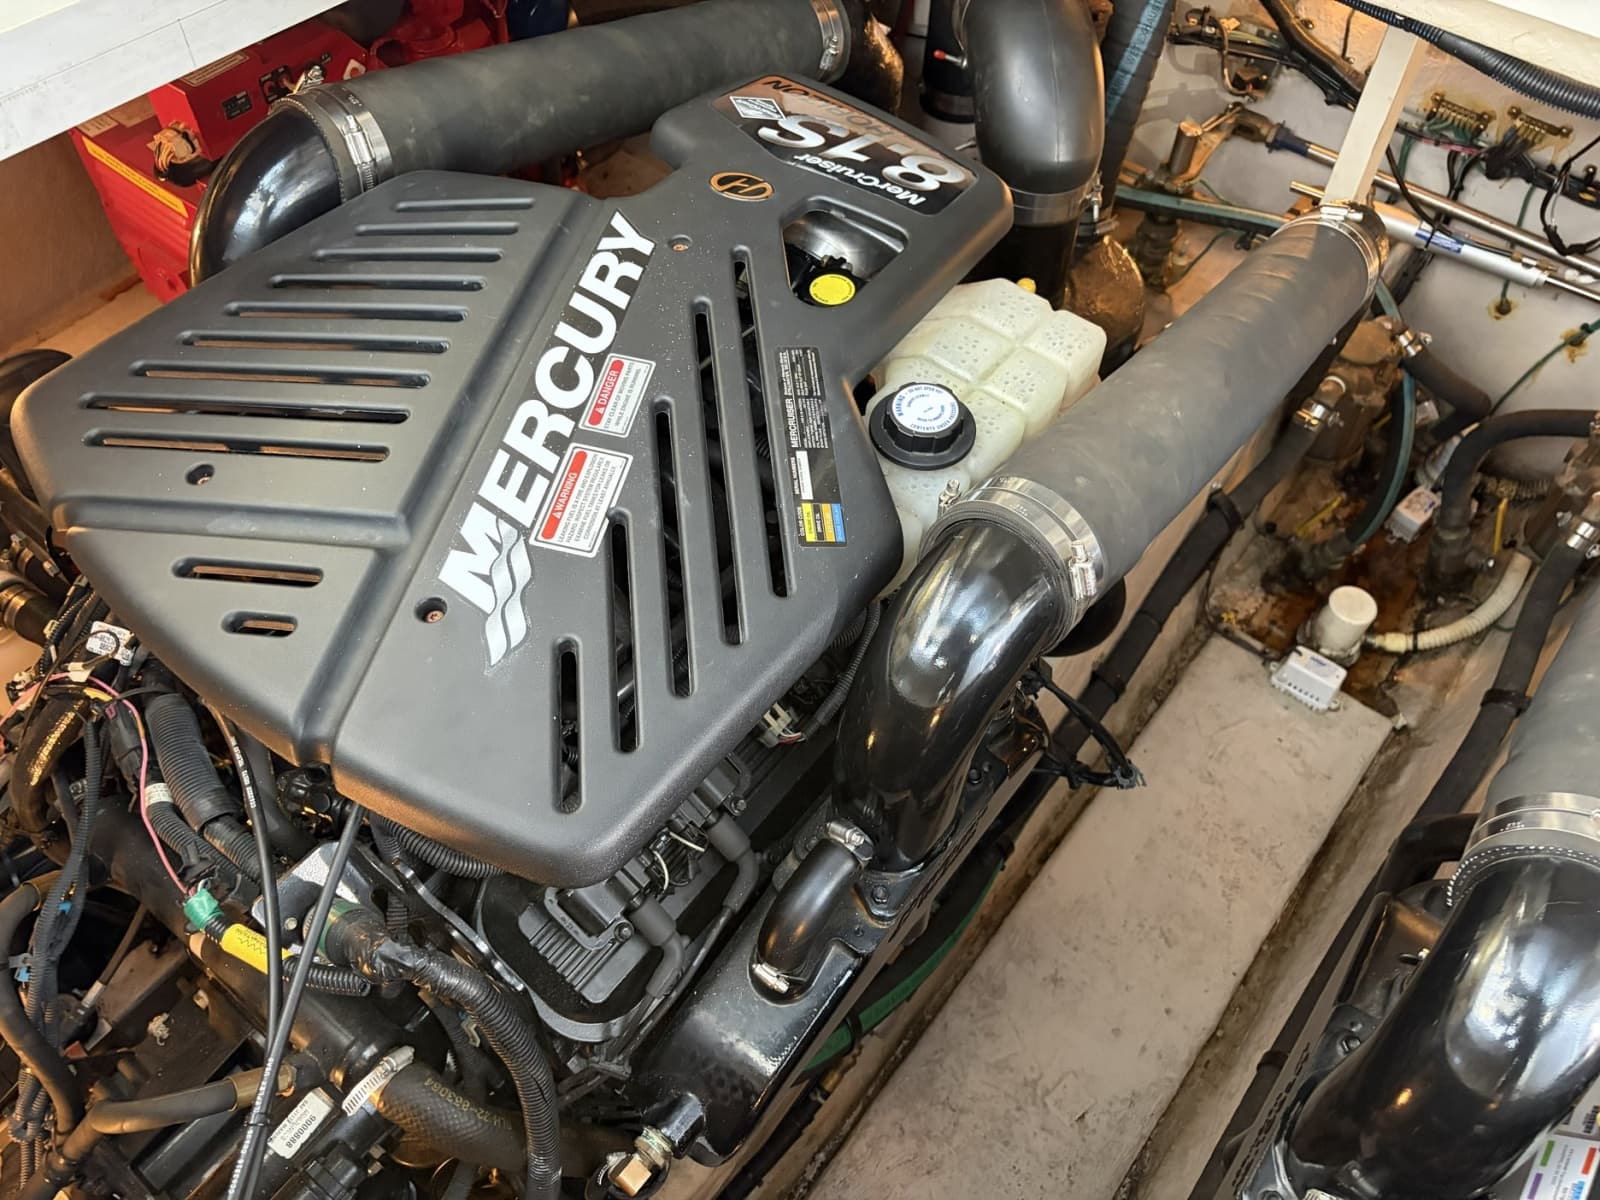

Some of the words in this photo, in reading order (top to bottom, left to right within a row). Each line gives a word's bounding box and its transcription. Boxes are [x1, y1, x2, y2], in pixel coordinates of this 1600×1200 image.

[761, 77, 893, 138] HORIZON
[758, 114, 967, 193] 8.1S
[793, 151, 927, 206] MerCruiser
[599, 369, 619, 406] DANGER
[608, 400, 618, 417] CLEAR
[624, 361, 634, 376] PARTS
[614, 410, 624, 426] WHILE
[620, 393, 630, 411] ENGINE
[438, 210, 656, 667] MERCURY
[786, 398, 798, 447] MERCRUISER
[556, 472, 577, 510] WARNING
[557, 520, 570, 542] LEAKING
[566, 508, 575, 522] FUEL
[575, 487, 584, 499] FIRE
[583, 452, 598, 479] EXPLOSION
[573, 520, 586, 542] EXAMINE
[582, 508, 591, 520] FUEL
[587, 492, 598, 508] TANKS
[597, 467, 608, 483] LEAKS
[574, 501, 586, 521] INSPECT
[582, 483, 593, 502] SYSTEM
[583, 510, 598, 540] CORROSION
[597, 489, 607, 504] LEAST
[284, 1113, 317, 1149] 9000888
